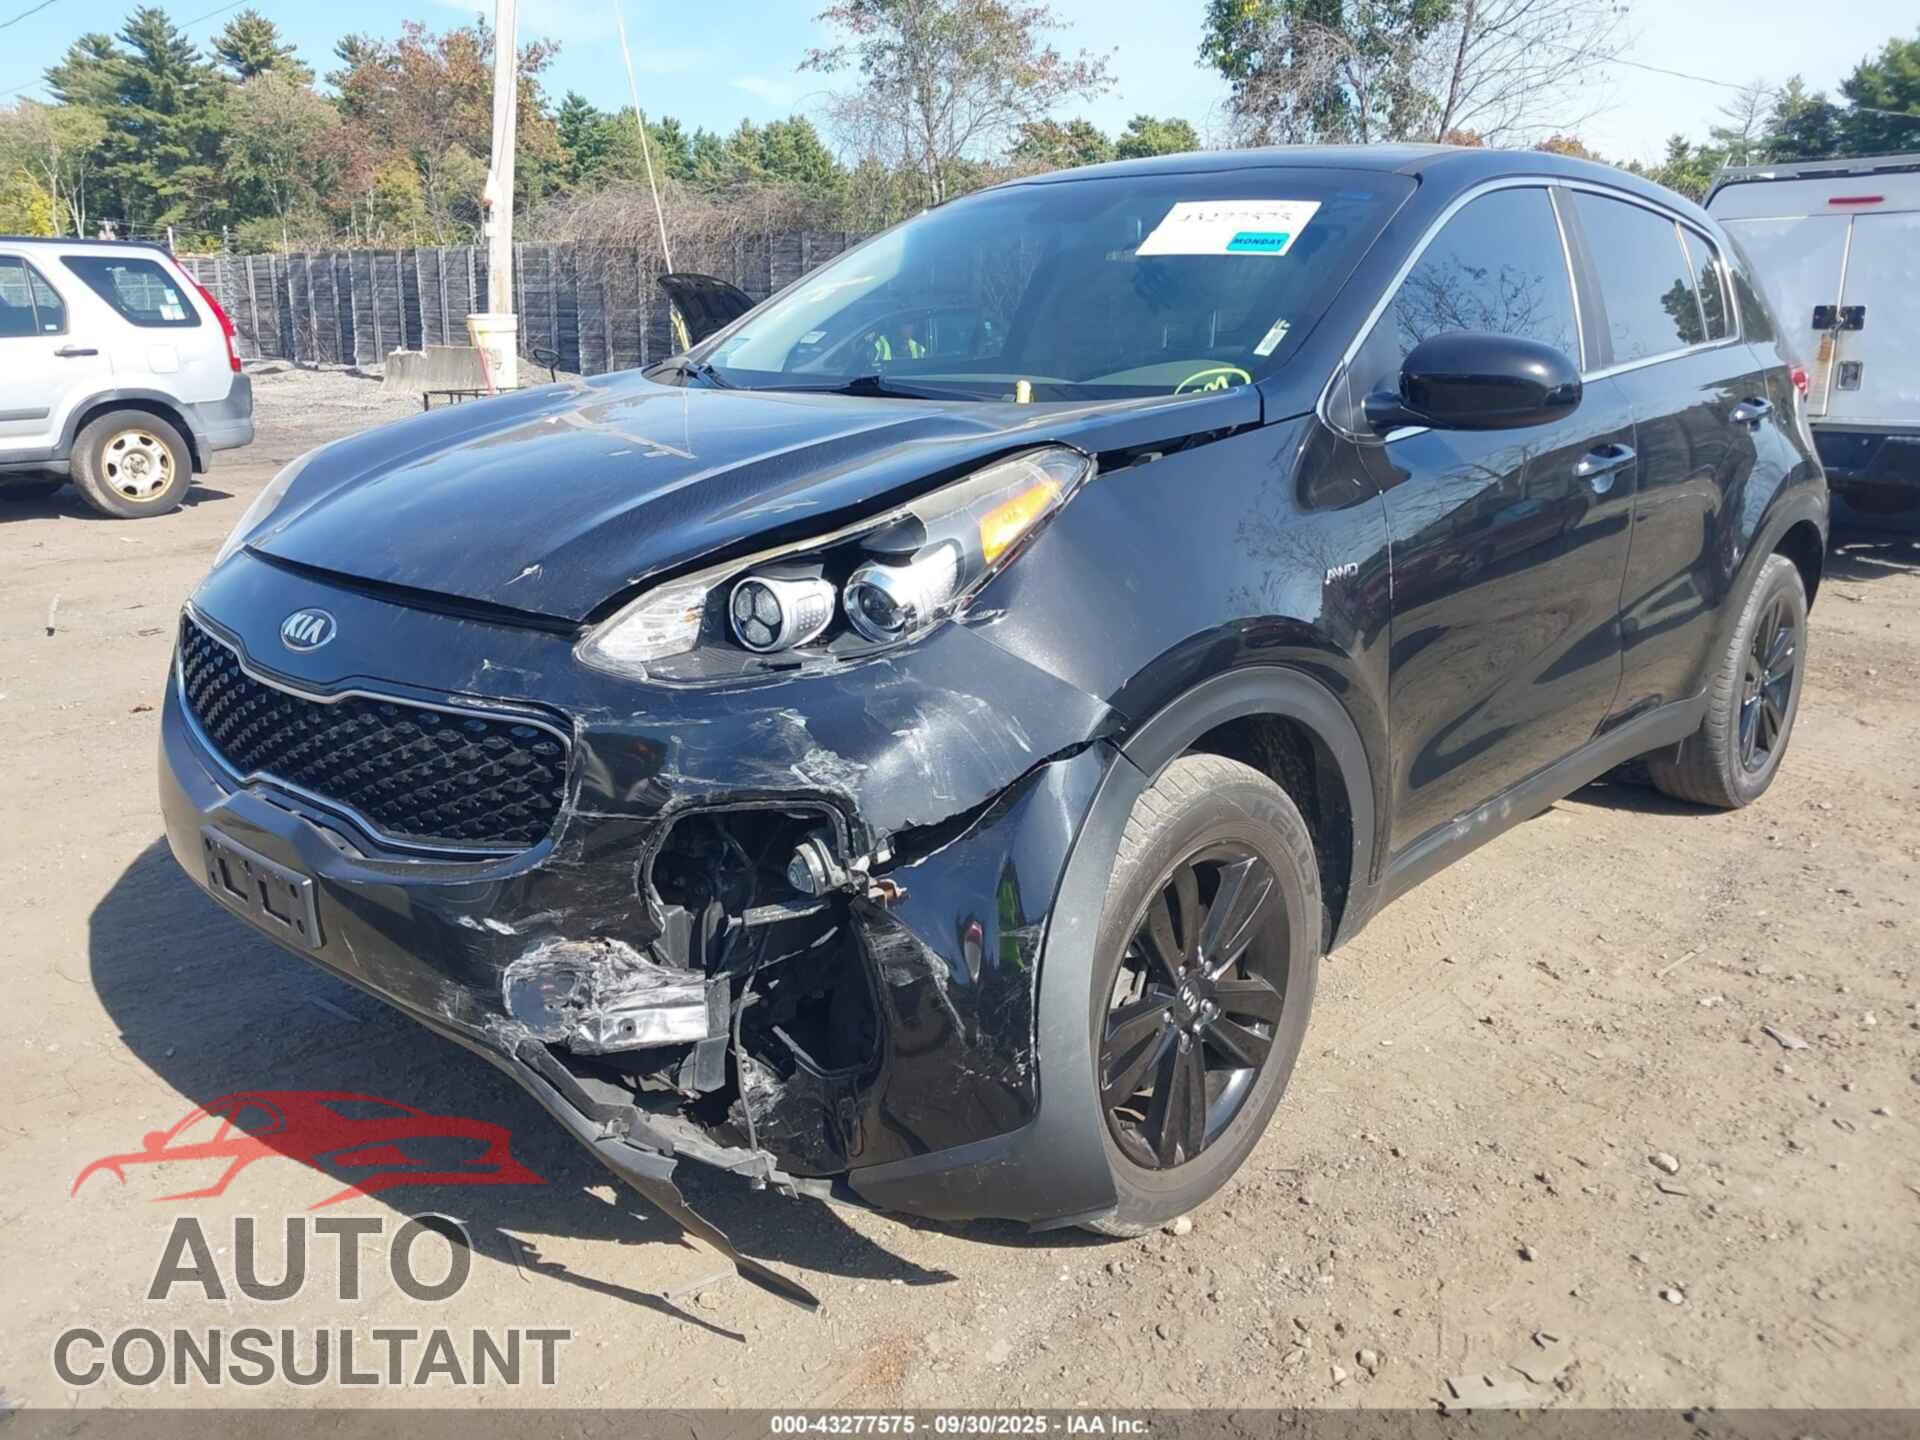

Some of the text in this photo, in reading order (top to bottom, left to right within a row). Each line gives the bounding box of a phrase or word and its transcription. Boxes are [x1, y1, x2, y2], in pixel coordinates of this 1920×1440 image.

[1232, 237, 1283, 245] MONDAY
[1325, 562, 1359, 585] AWD
[283, 613, 325, 643] KIA
